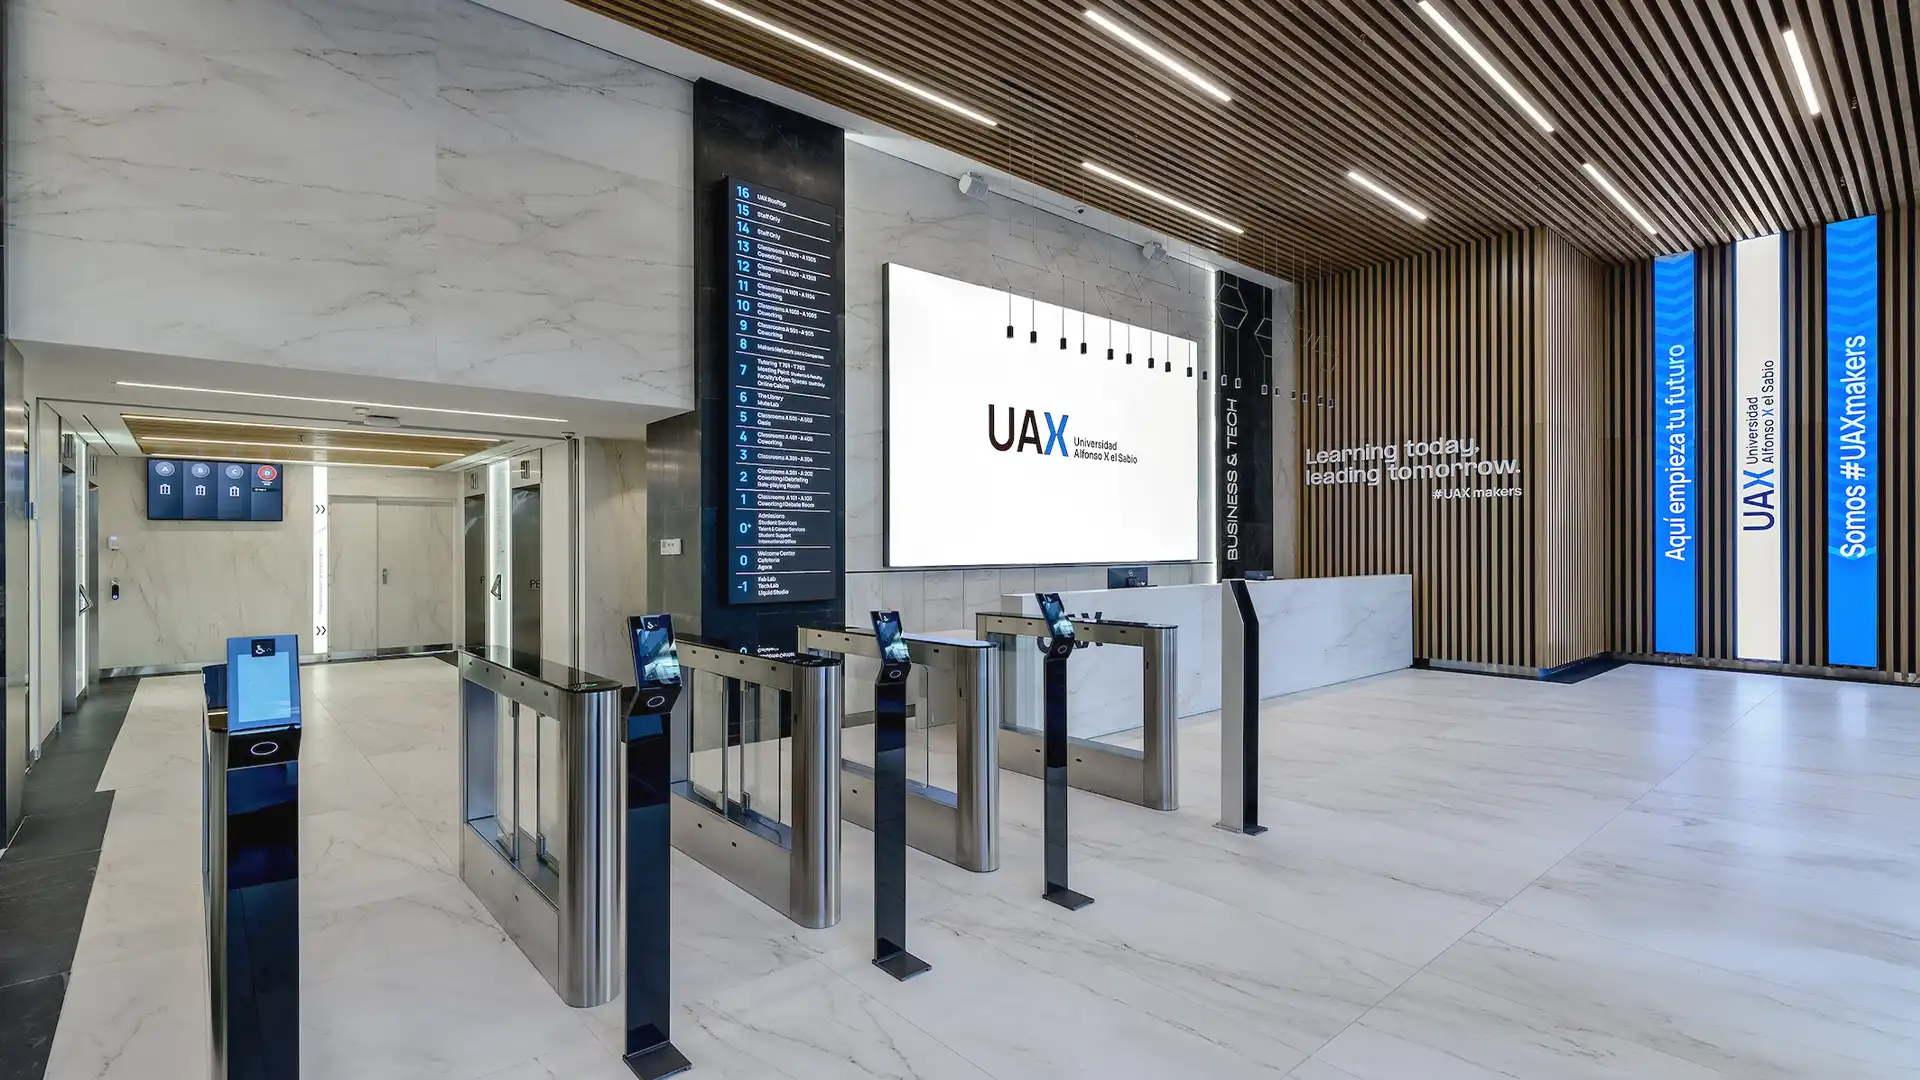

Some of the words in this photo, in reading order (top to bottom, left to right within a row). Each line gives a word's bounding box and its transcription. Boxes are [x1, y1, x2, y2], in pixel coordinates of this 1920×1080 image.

[736, 186, 750, 199] 16
[768, 197, 786, 208] Rooftop
[737, 204, 750, 216] 15
[770, 215, 780, 224] Only
[737, 221, 750, 234] 14
[770, 232, 780, 240] Only
[737, 240, 750, 252] 13
[757, 244, 785, 255] Classrooms
[737, 260, 750, 272] 12
[757, 263, 785, 274] Classrooms
[738, 280, 748, 292] 11
[757, 282, 784, 294] Classrooms
[737, 299, 750, 312] 10
[757, 302, 784, 313] Classrooms
[740, 320, 748, 330] 9
[757, 322, 785, 332] Classrooms
[740, 338, 747, 350] 8
[740, 364, 747, 376] 7
[1665, 344, 1685, 406] futuro
[1762, 360, 1774, 393] Sabio
[740, 392, 747, 402] 6
[1762, 395, 1774, 406] el
[1762, 408, 1774, 417] X
[1840, 335, 1866, 481] #UAXmakers
[740, 412, 747, 422] 5
[757, 412, 784, 420] Classrooms
[1667, 412, 1685, 431] tu
[1227, 398, 1237, 449] TECH
[740, 431, 747, 442] 4
[757, 431, 784, 440] Classrooms
[988, 404, 1069, 457] UAX
[1746, 397, 1758, 465] Universidad
[1073, 437, 1118, 450] Universidad
[1762, 419, 1774, 464] Alfonso
[740, 450, 747, 460] 3
[1306, 443, 1398, 464] Learning
[1404, 436, 1480, 458] today,
[1074, 449, 1102, 461] Alfonso
[1103, 451, 1109, 462] X
[1111, 452, 1117, 462] el
[1118, 453, 1138, 464] Sabio
[1227, 453, 1238, 466] &
[740, 471, 748, 482] 2
[1306, 466, 1380, 486] leading
[1387, 458, 1521, 481] tomorrow.
[1665, 433, 1691, 514] empieza
[741, 494, 746, 504] 1
[1432, 487, 1471, 500] #UAX
[1472, 486, 1522, 498] makers
[1743, 468, 1775, 531] UAX
[1227, 470, 1238, 561] BUSINESS
[1840, 485, 1866, 558] Somos
[1663, 517, 1691, 561] Aquí
[740, 555, 748, 566] 0
[737, 581, 747, 592] -1
